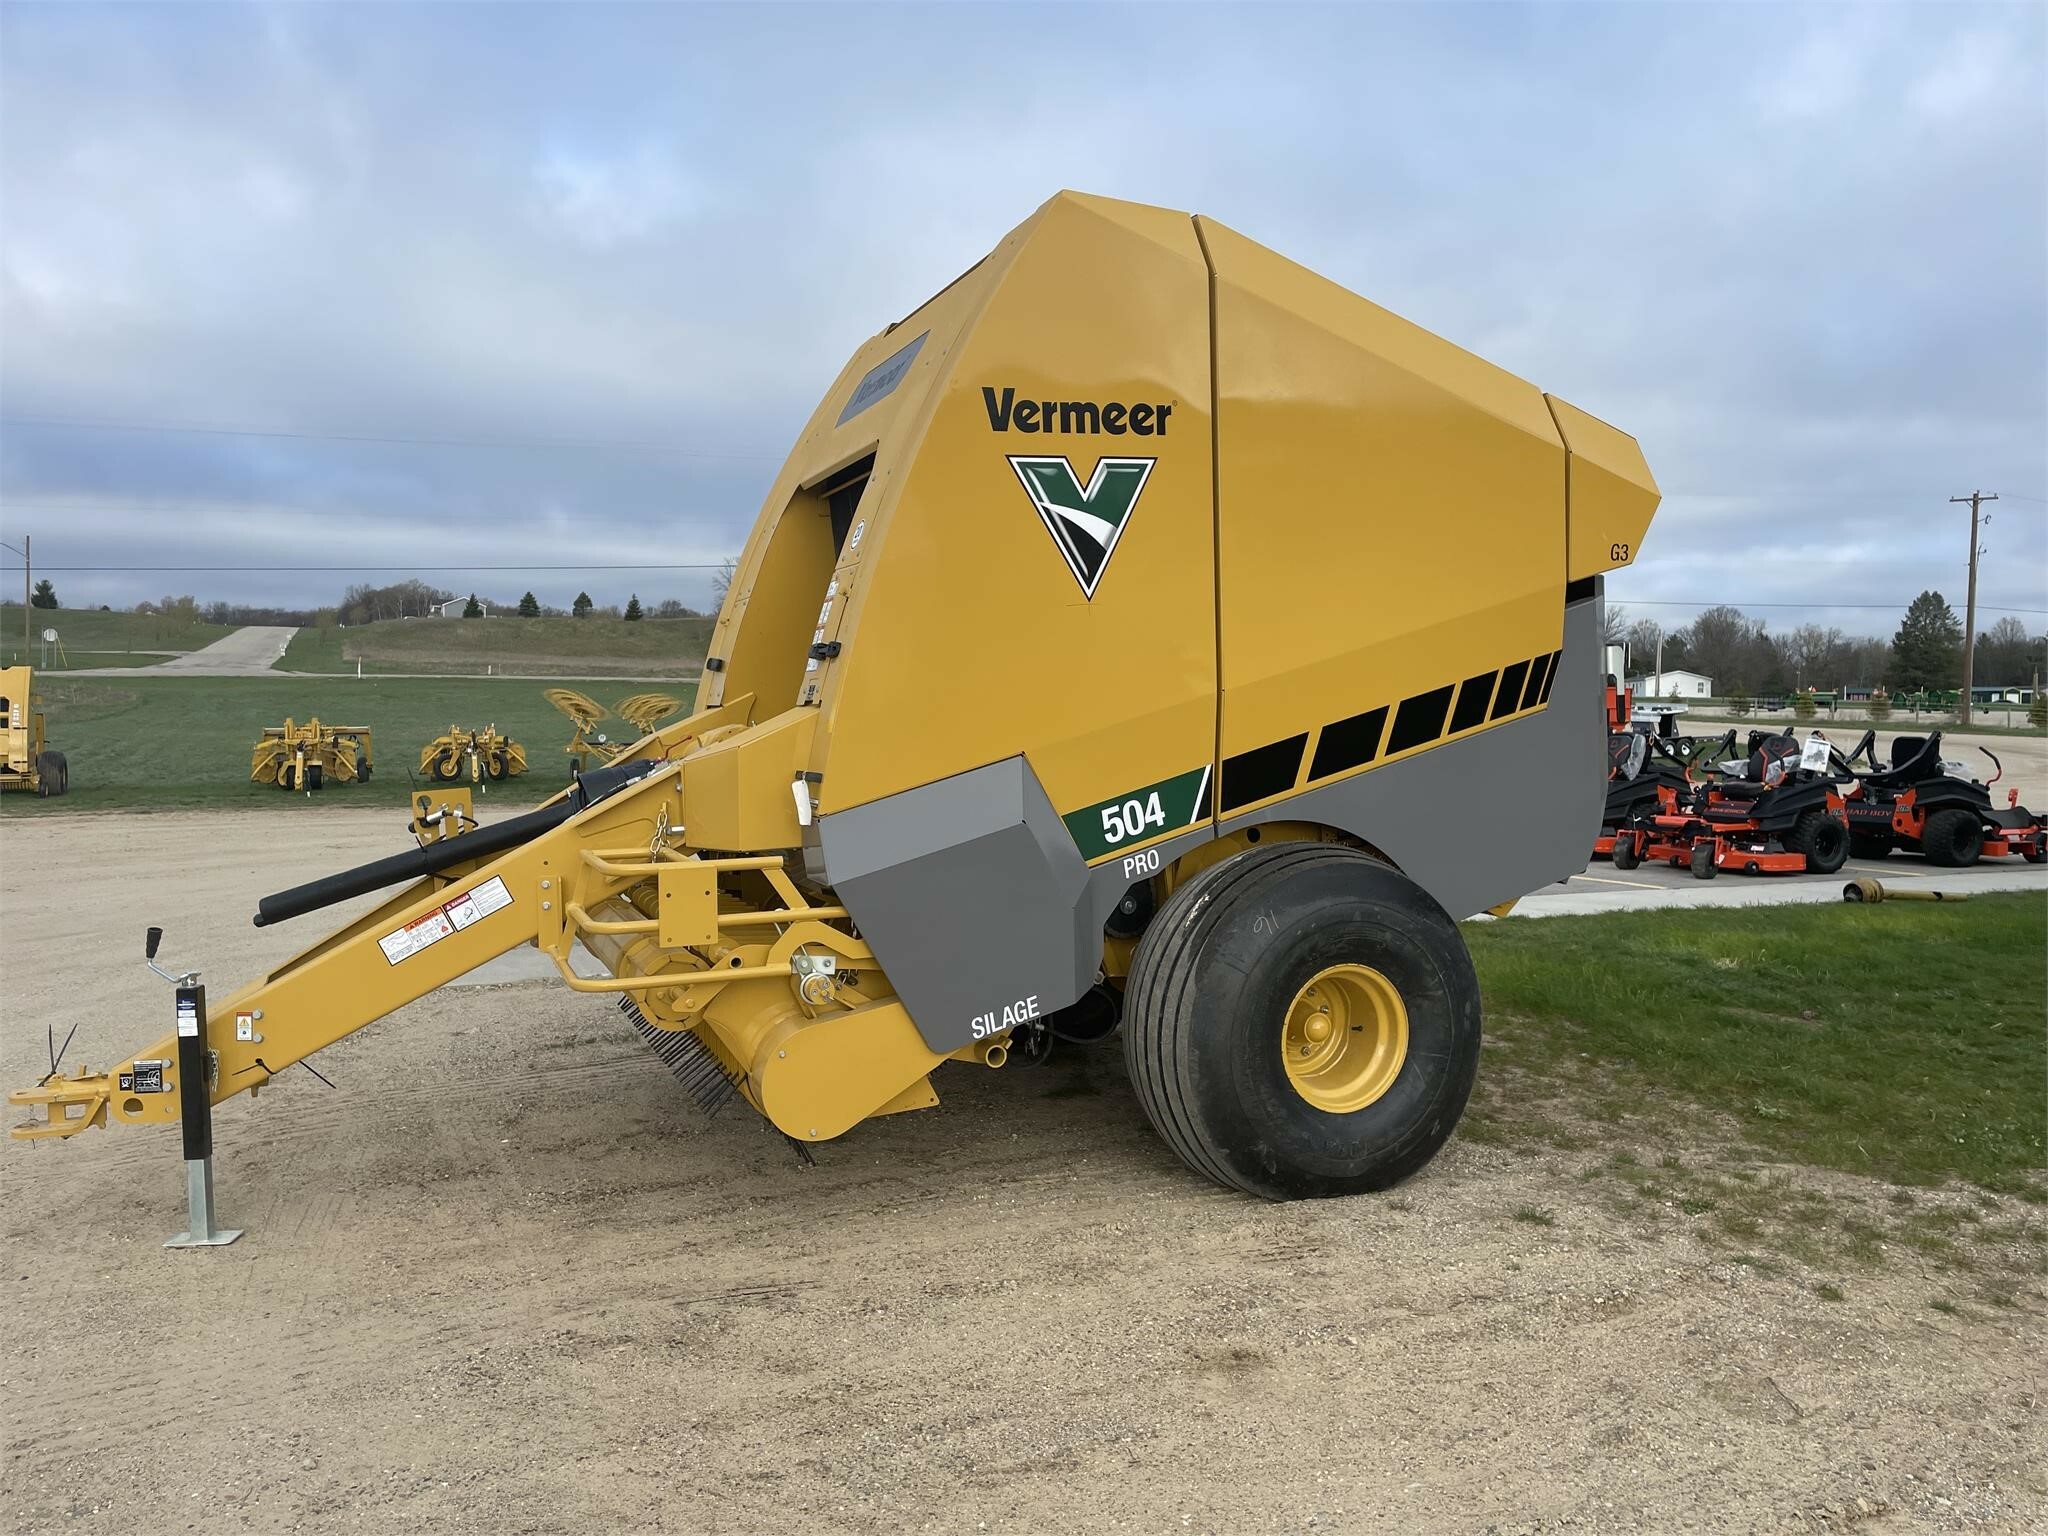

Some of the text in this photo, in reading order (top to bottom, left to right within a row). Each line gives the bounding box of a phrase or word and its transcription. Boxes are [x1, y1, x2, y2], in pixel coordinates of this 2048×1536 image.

[982, 386, 1171, 436] Vermeer
[1610, 543, 1629, 562] G3
[1101, 791, 1165, 844] 504
[1123, 849, 1160, 879] PRO
[971, 995, 1040, 1039] SILAGE
